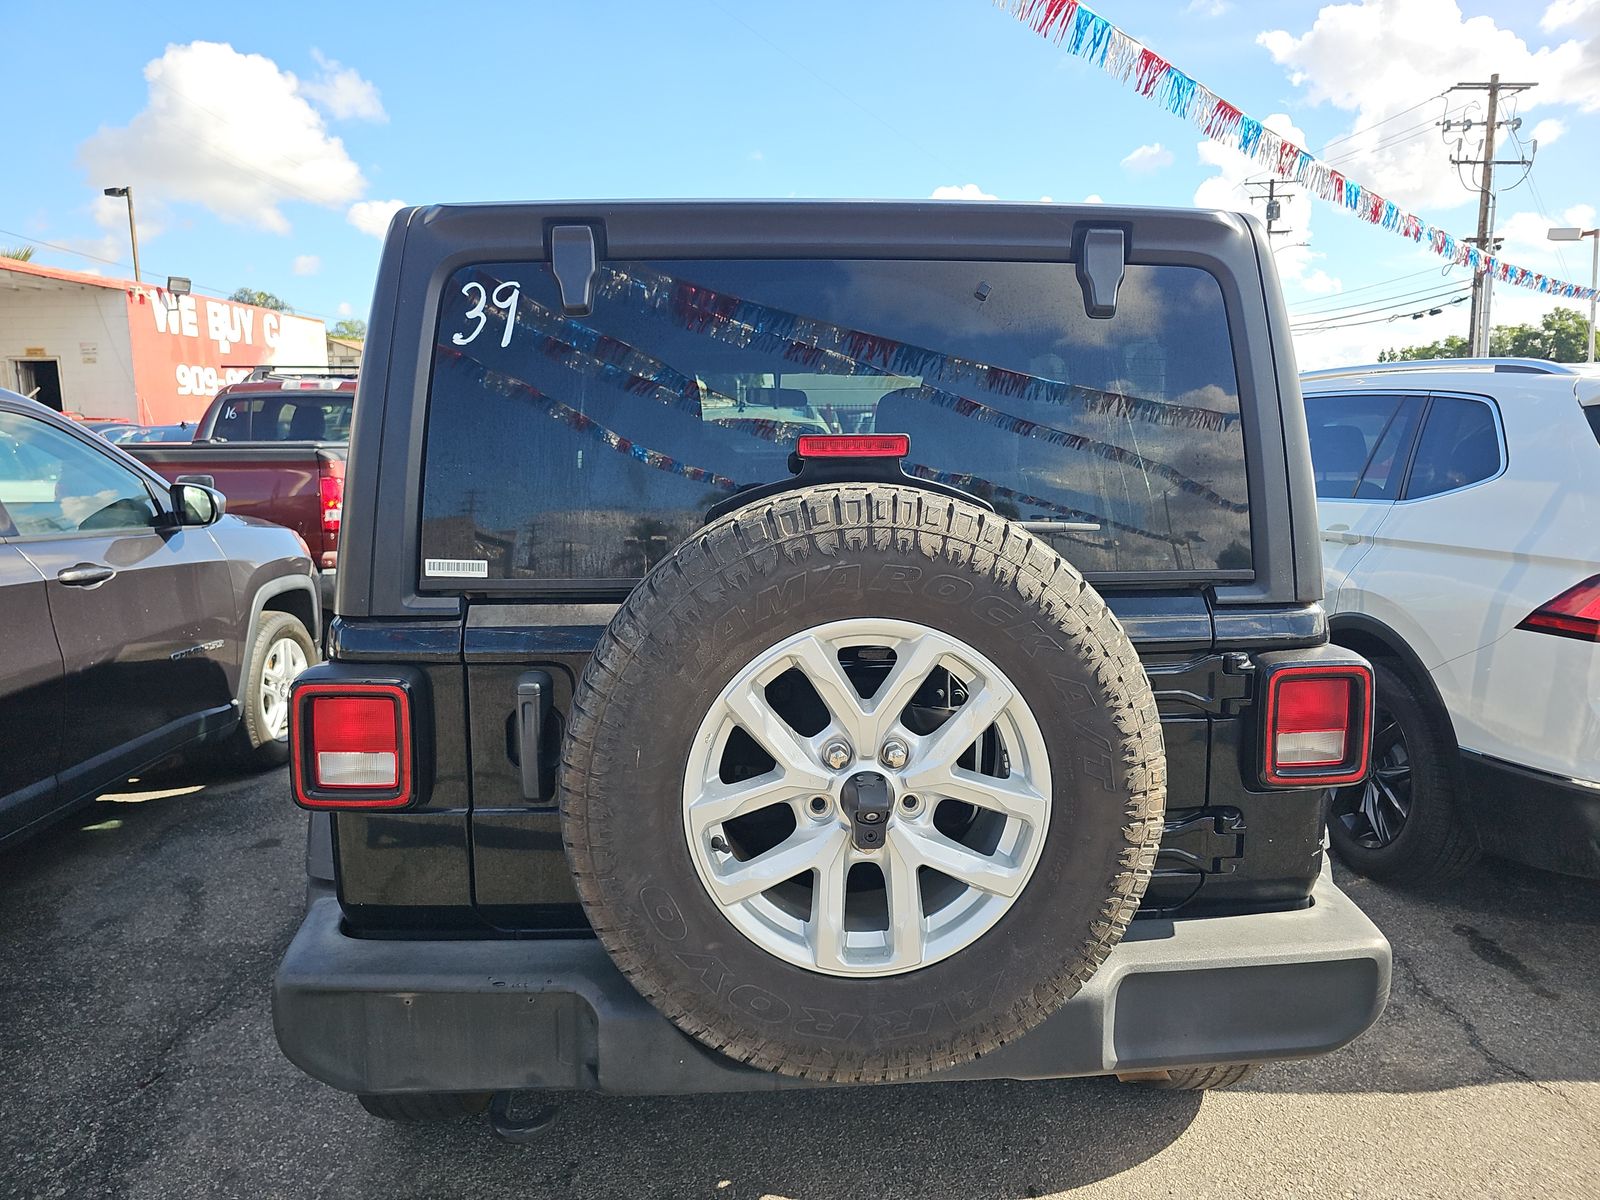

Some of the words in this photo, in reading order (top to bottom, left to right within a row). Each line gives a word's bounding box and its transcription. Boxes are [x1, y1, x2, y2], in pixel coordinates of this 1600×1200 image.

[149, 289, 199, 338] WE
[206, 300, 254, 352] BUY
[452, 281, 521, 348] 39
[225, 406, 238, 420] 16
[639, 886, 1006, 1041] ARROYO
